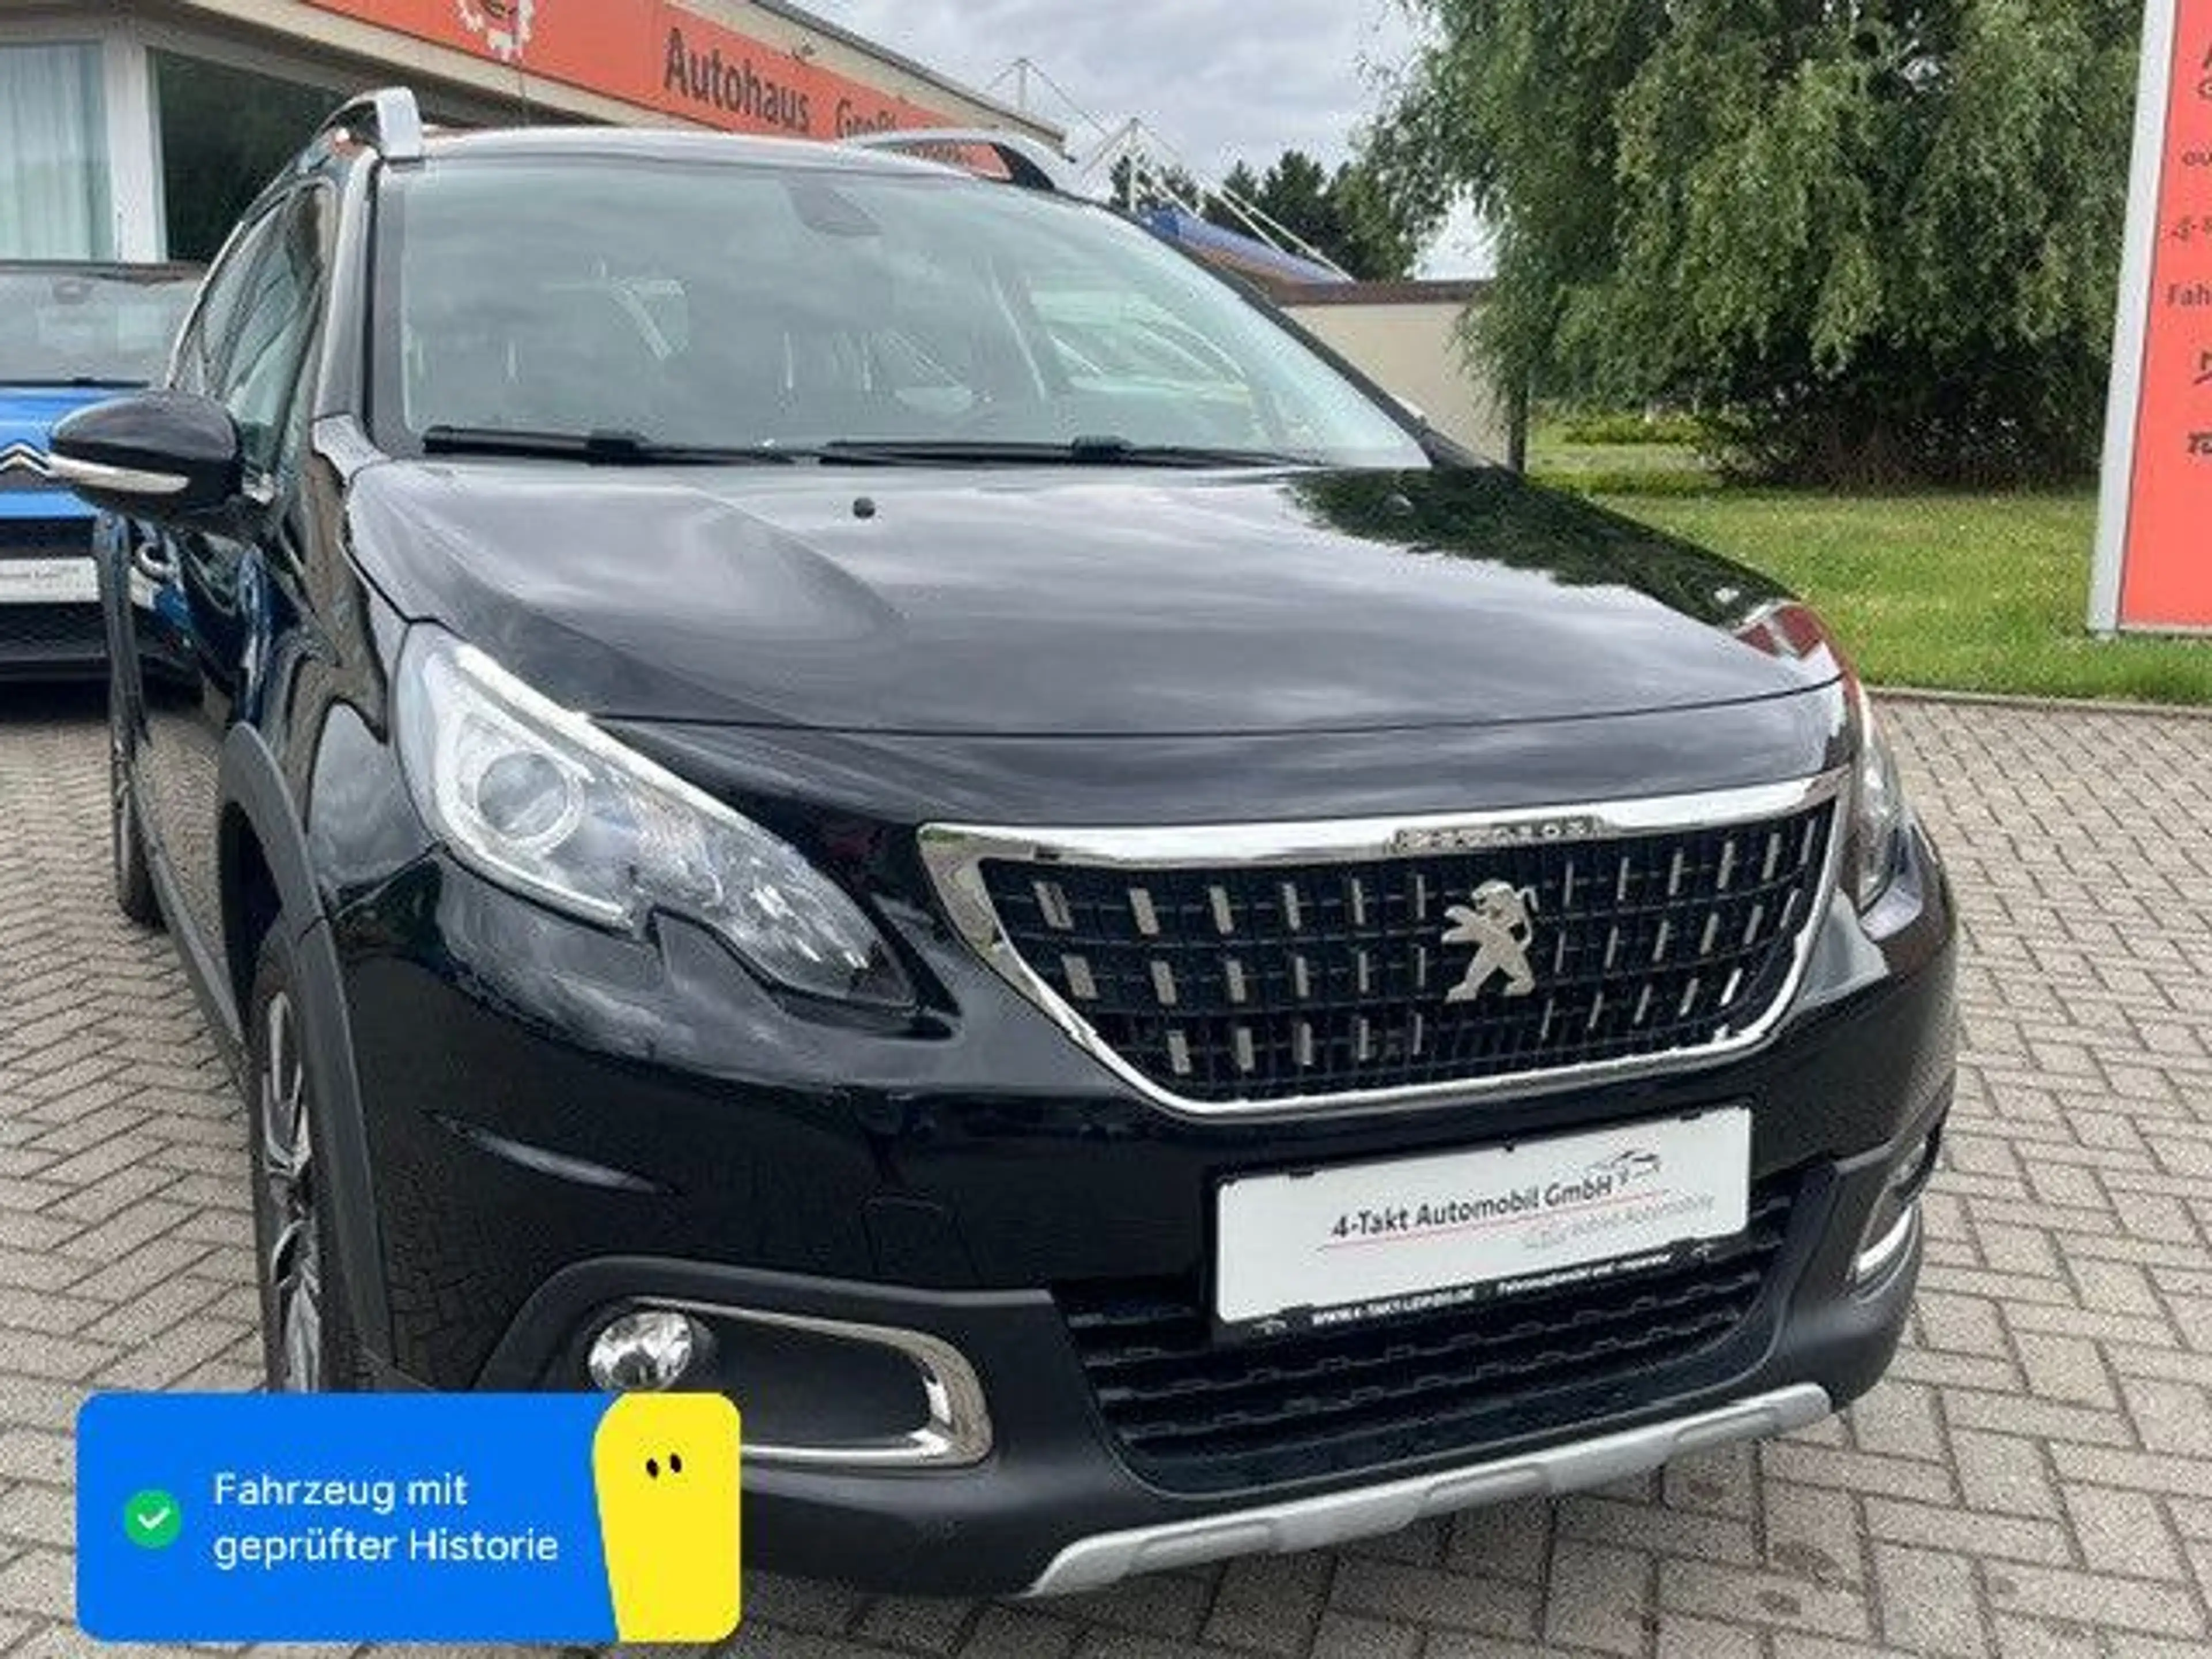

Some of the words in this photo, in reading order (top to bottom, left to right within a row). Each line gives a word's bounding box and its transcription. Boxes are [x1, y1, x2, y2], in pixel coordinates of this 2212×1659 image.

[664, 26, 811, 132] Autohaus
[1332, 1209, 1408, 1238] 4-Takt
[1416, 1185, 1540, 1226] Automobil
[1544, 1174, 1612, 1208] GmbH
